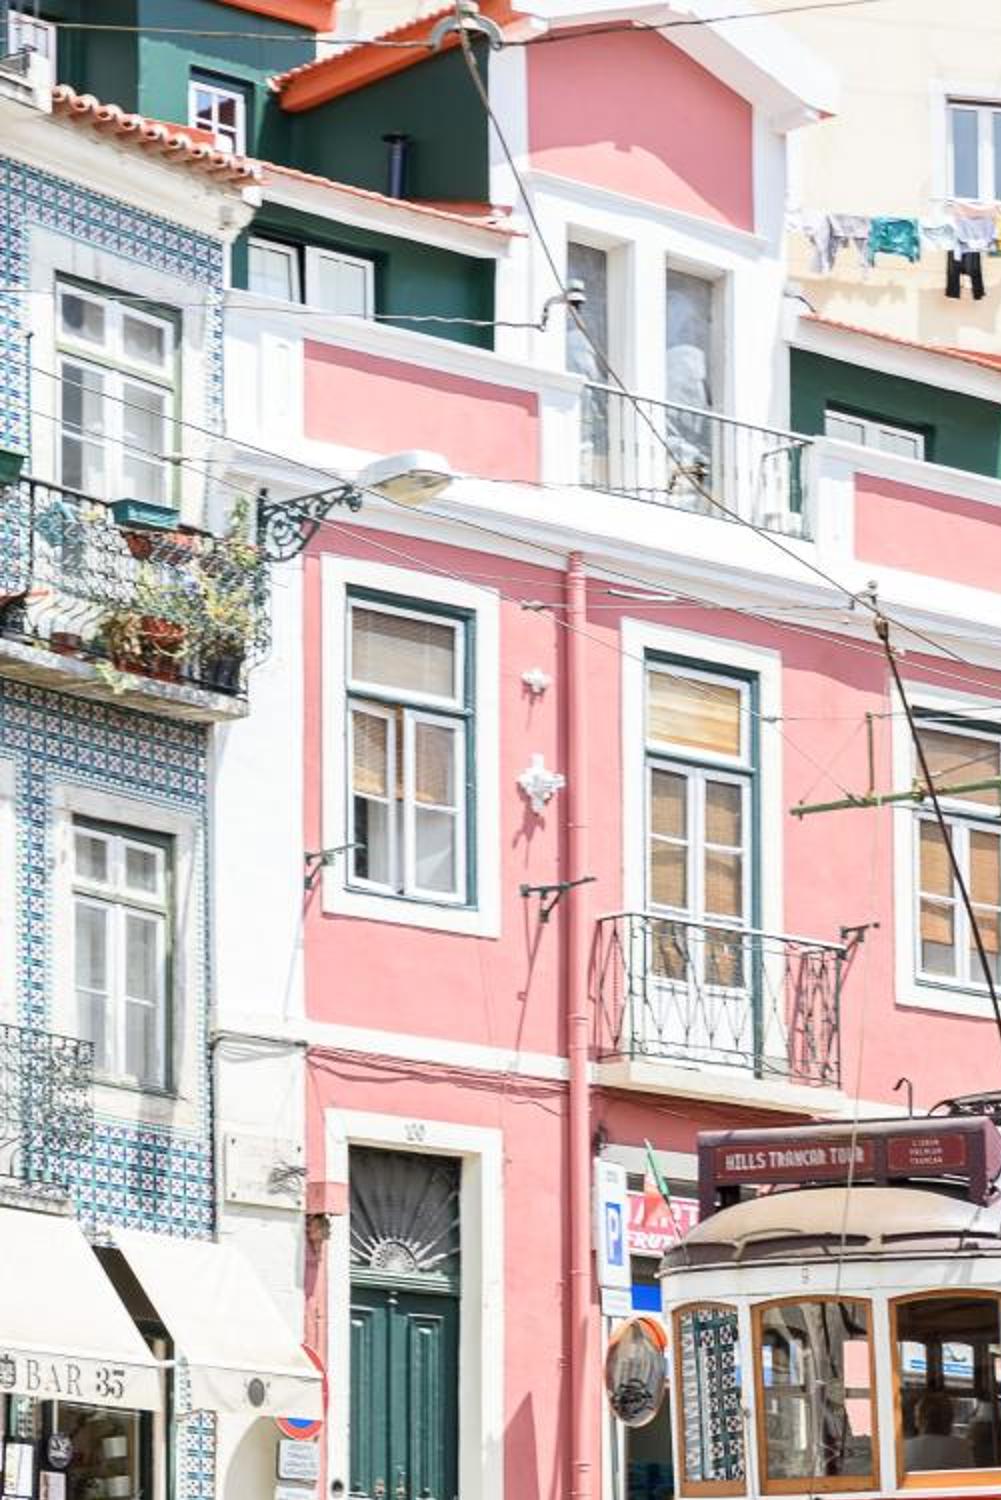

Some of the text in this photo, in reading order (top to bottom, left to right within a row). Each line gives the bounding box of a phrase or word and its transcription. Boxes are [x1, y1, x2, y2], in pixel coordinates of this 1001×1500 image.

[725, 1152, 766, 1171] HILLS
[829, 1146, 865, 1164] TOUR
[26, 1359, 126, 1399] BAR 35
